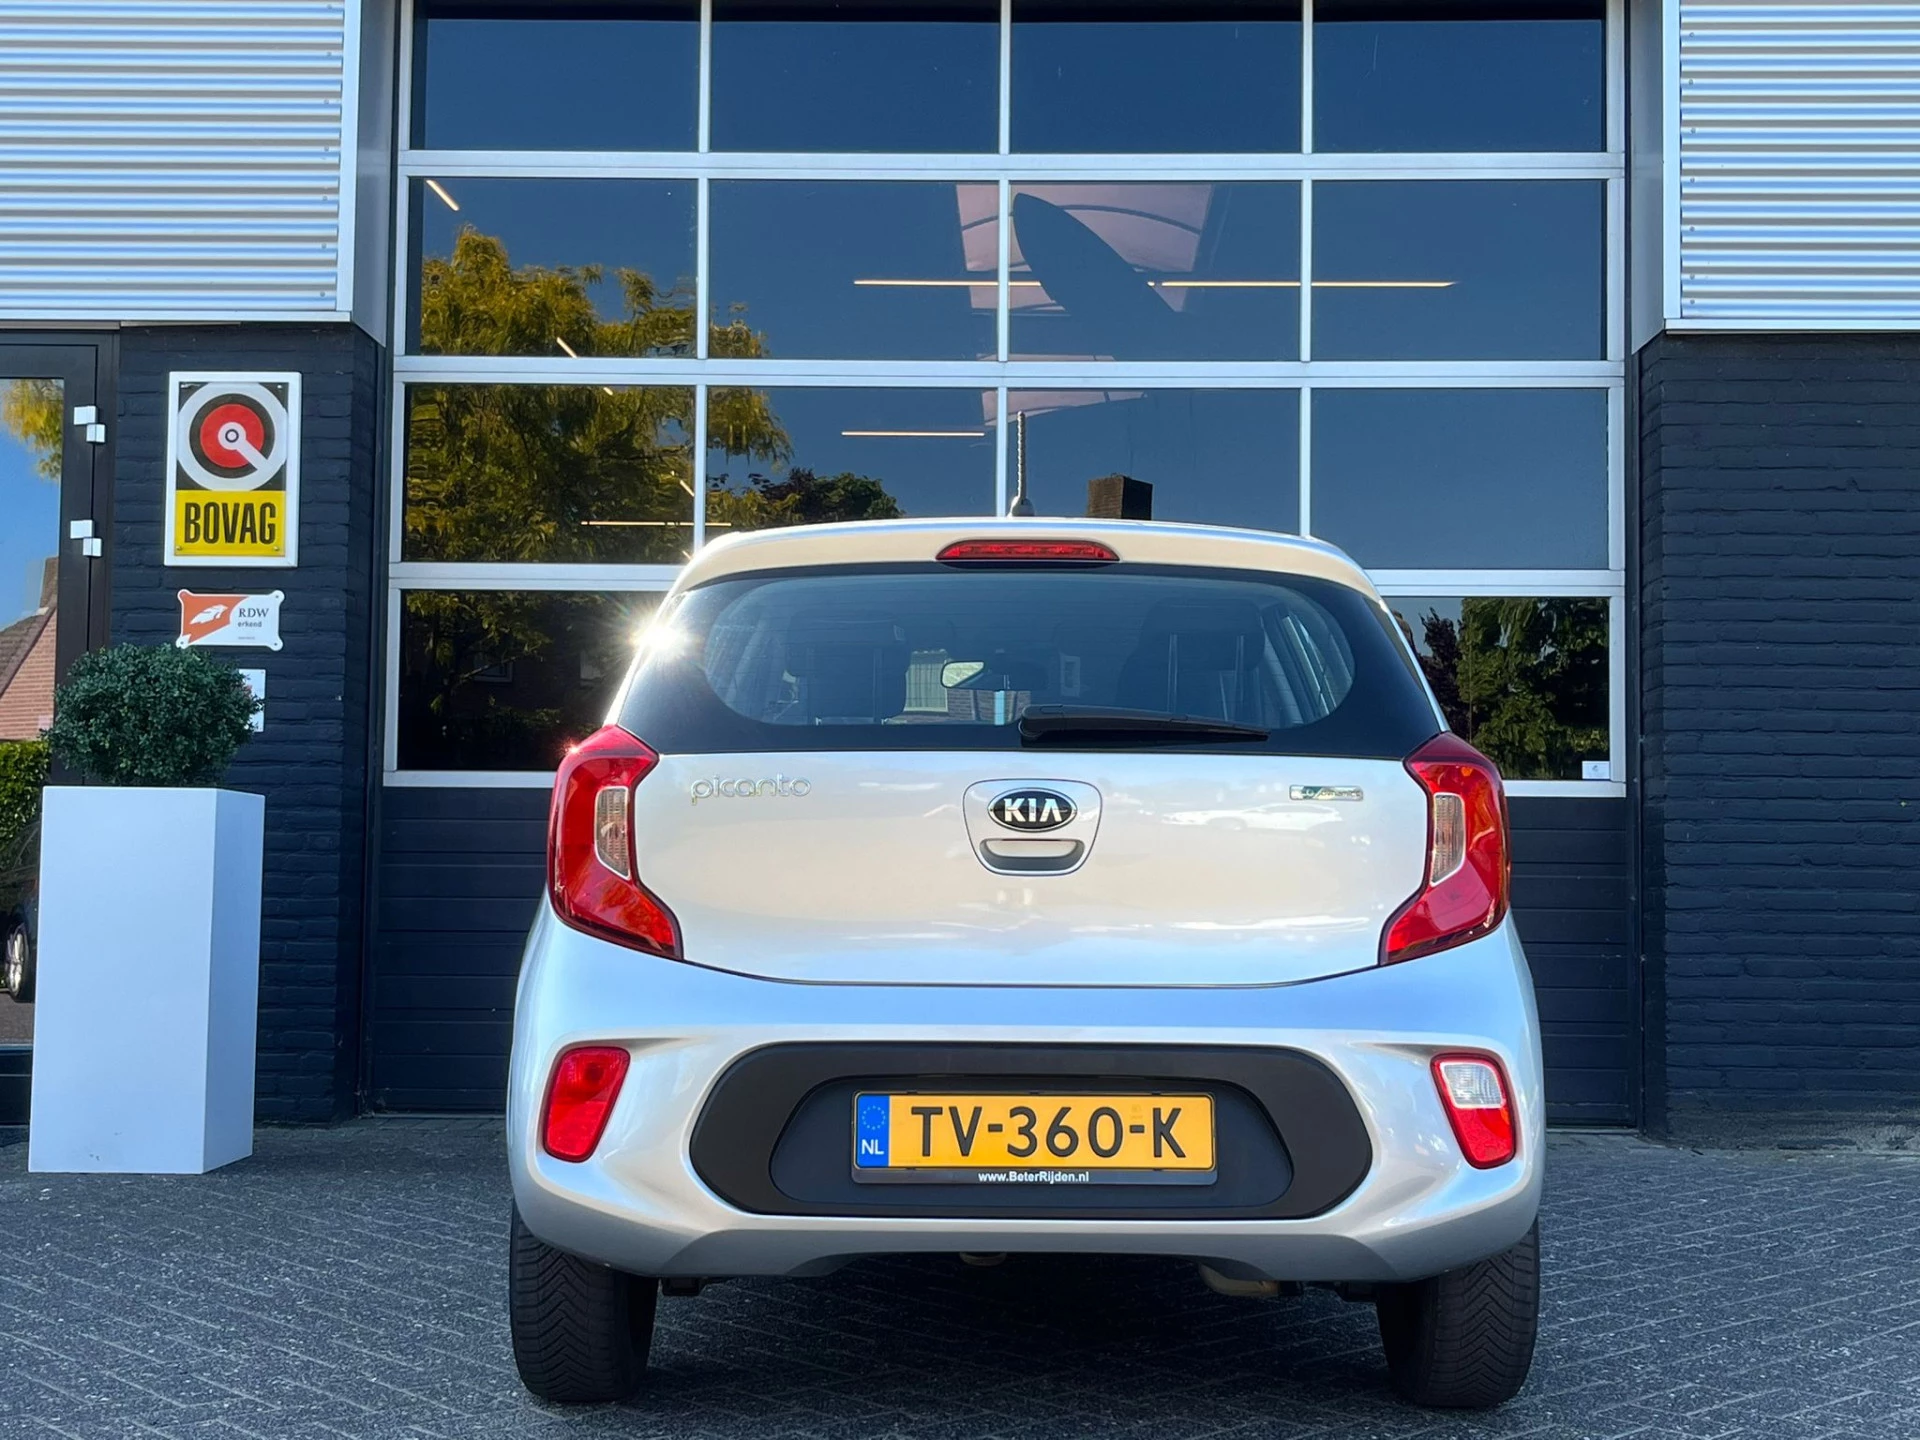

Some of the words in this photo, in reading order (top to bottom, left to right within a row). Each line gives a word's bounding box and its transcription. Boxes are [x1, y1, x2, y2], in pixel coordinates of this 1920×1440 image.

[184, 502, 277, 544] BOVAG
[238, 607, 269, 618] RDW
[690, 773, 811, 806] picanto
[1003, 797, 1062, 822] KIA
[911, 1106, 1187, 1158] TV-360-K
[861, 1139, 885, 1155] NL
[978, 1170, 1090, 1184] www.BeterRijden.nl
